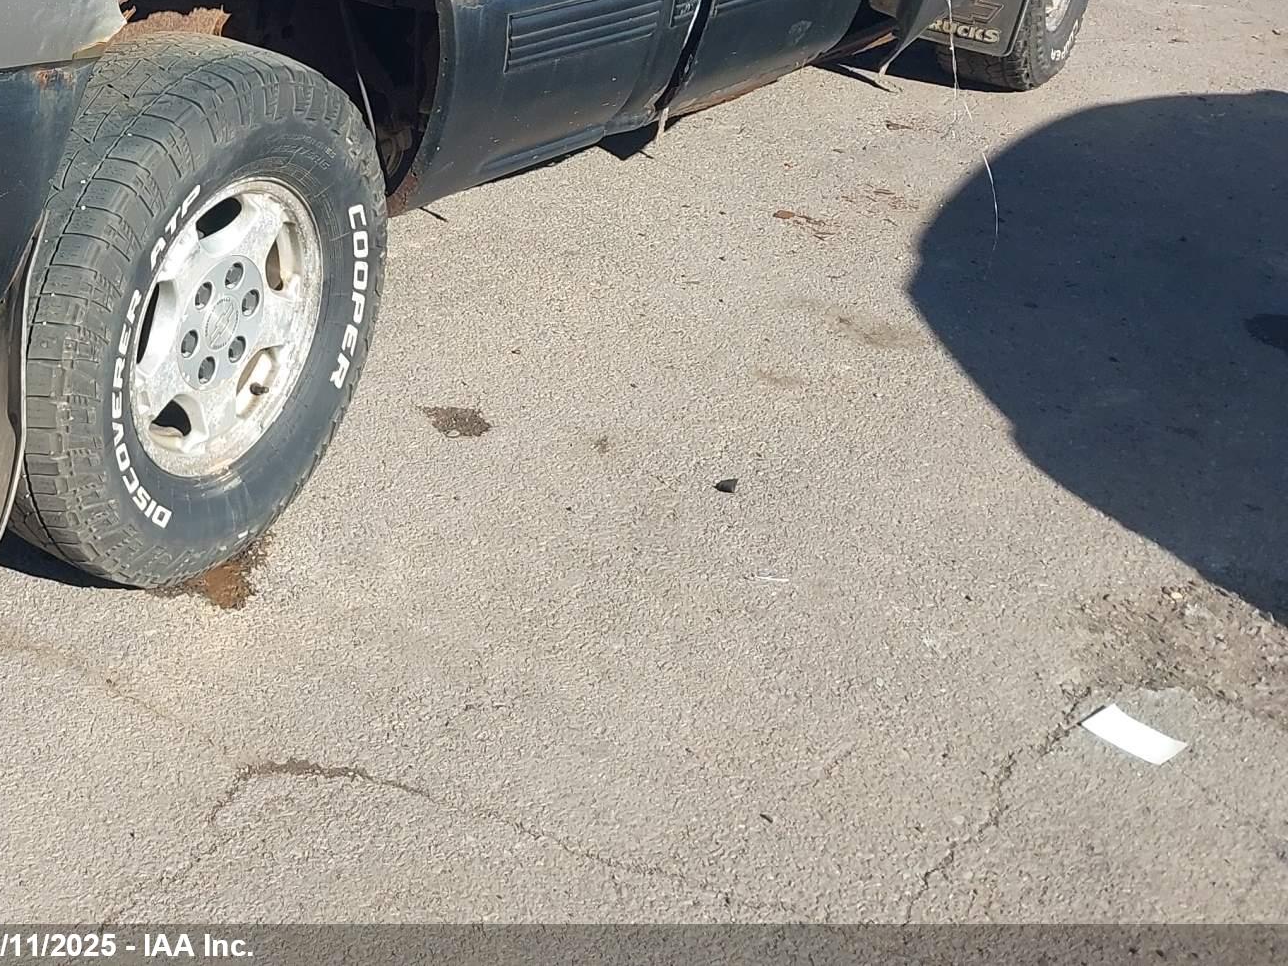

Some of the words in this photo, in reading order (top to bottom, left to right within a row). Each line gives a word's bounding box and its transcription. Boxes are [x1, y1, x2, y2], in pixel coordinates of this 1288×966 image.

[112, 289, 173, 529] DISCOVERER
[150, 184, 202, 272] ATP
[329, 204, 369, 390] COOPER
